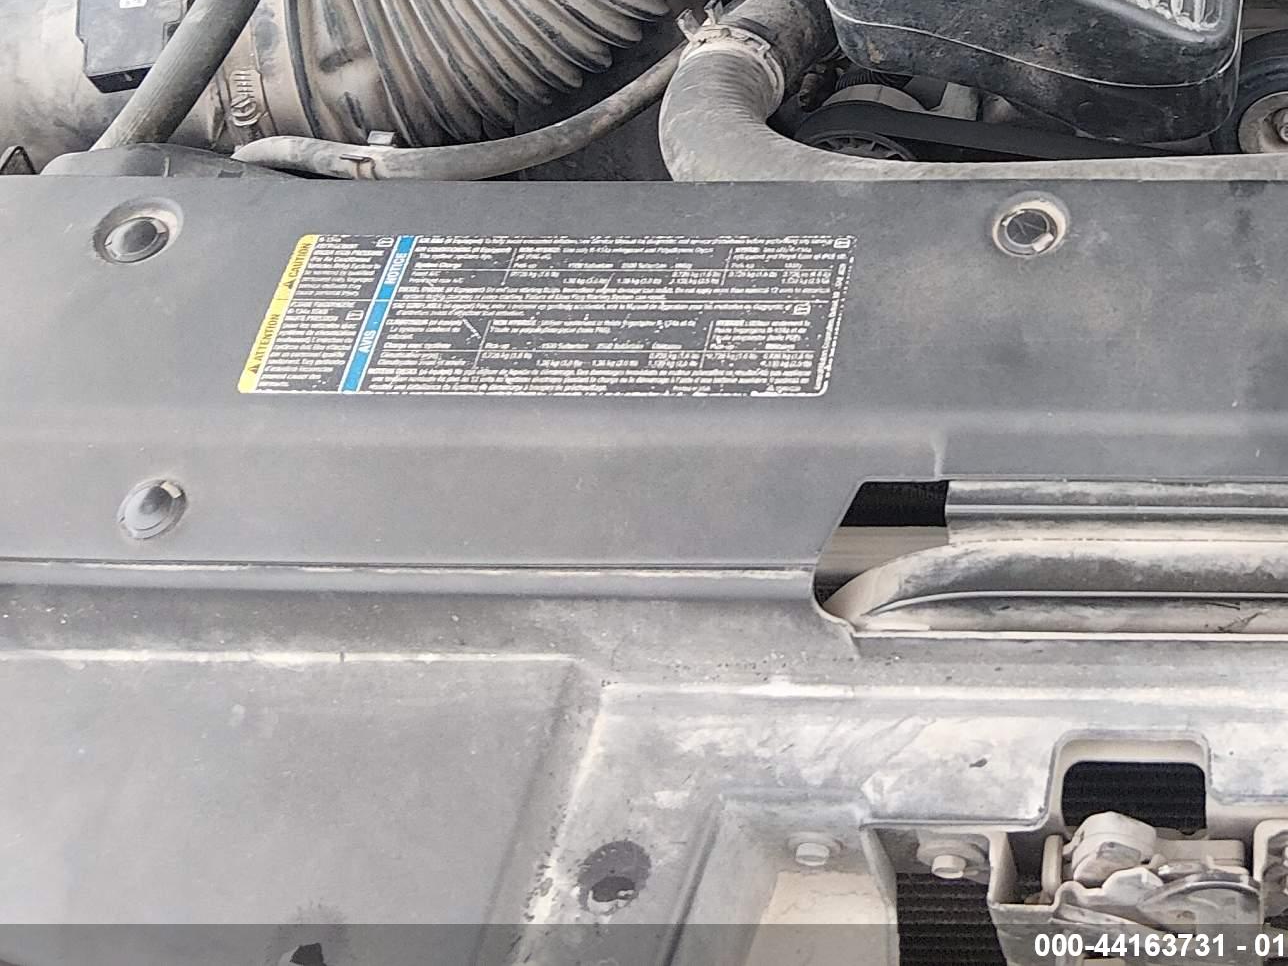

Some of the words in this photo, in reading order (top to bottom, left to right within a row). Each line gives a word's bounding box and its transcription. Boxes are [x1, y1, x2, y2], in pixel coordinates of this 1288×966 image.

[289, 242, 312, 277] CAUTION
[384, 253, 408, 285] NOTICE
[256, 313, 280, 362] ATTENTION
[358, 330, 377, 354] AVIS
